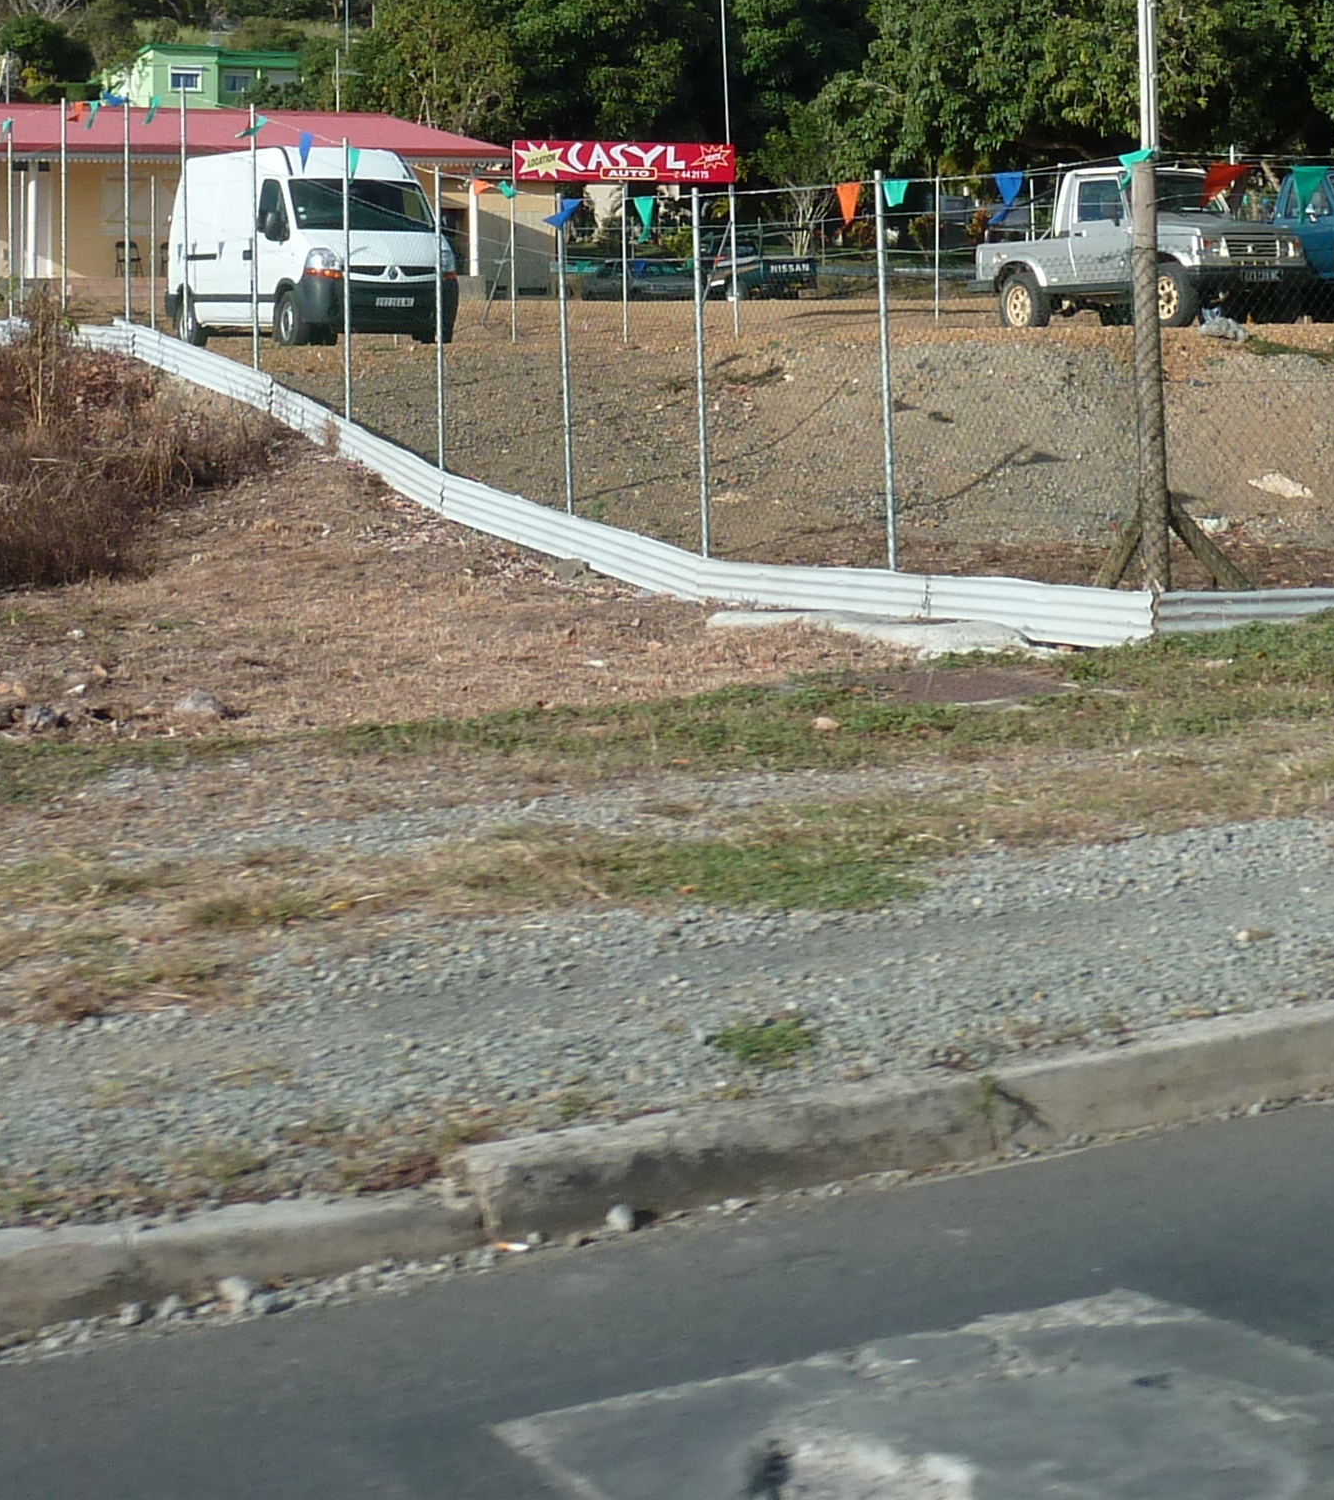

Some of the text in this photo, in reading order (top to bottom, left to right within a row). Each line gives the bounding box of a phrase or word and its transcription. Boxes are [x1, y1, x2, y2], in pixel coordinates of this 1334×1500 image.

[527, 153, 556, 168] LOCATION
[567, 142, 685, 171] CASYL
[608, 169, 650, 177] AUTO
[770, 263, 810, 273] NISSAN
